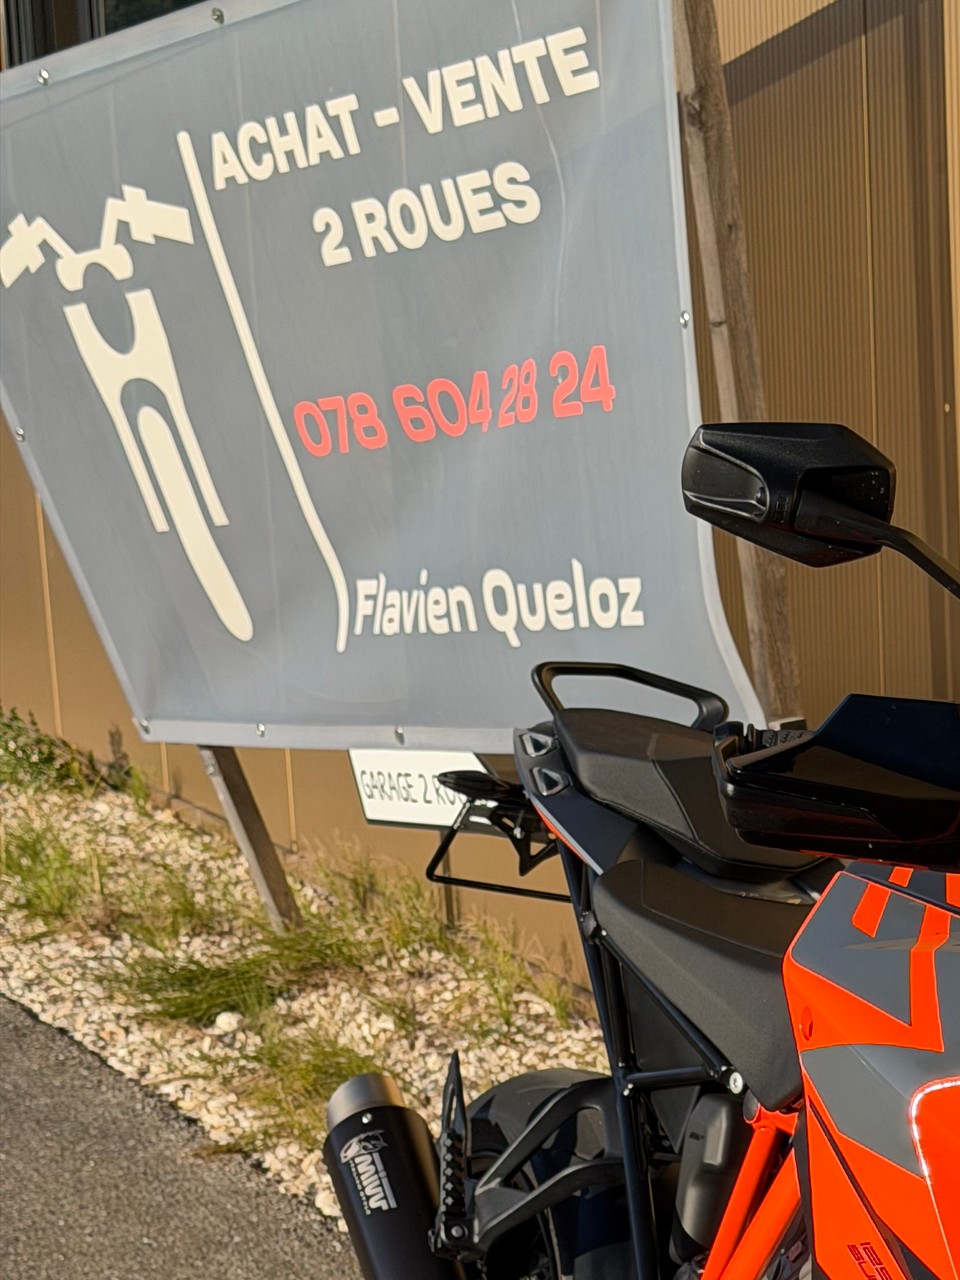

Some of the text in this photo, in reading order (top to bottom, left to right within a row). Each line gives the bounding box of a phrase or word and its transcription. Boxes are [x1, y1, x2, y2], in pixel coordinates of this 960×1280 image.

[211, 94, 361, 190] ACHAT
[402, 27, 600, 134] VENTE
[313, 161, 541, 266] 2 ROUES
[294, 391, 388, 457] 078
[550, 345, 616, 418] 24
[354, 558, 645, 648] Flavien Queloz
[360, 769, 418, 803] GARAGE
[418, 773, 432, 804] 2
